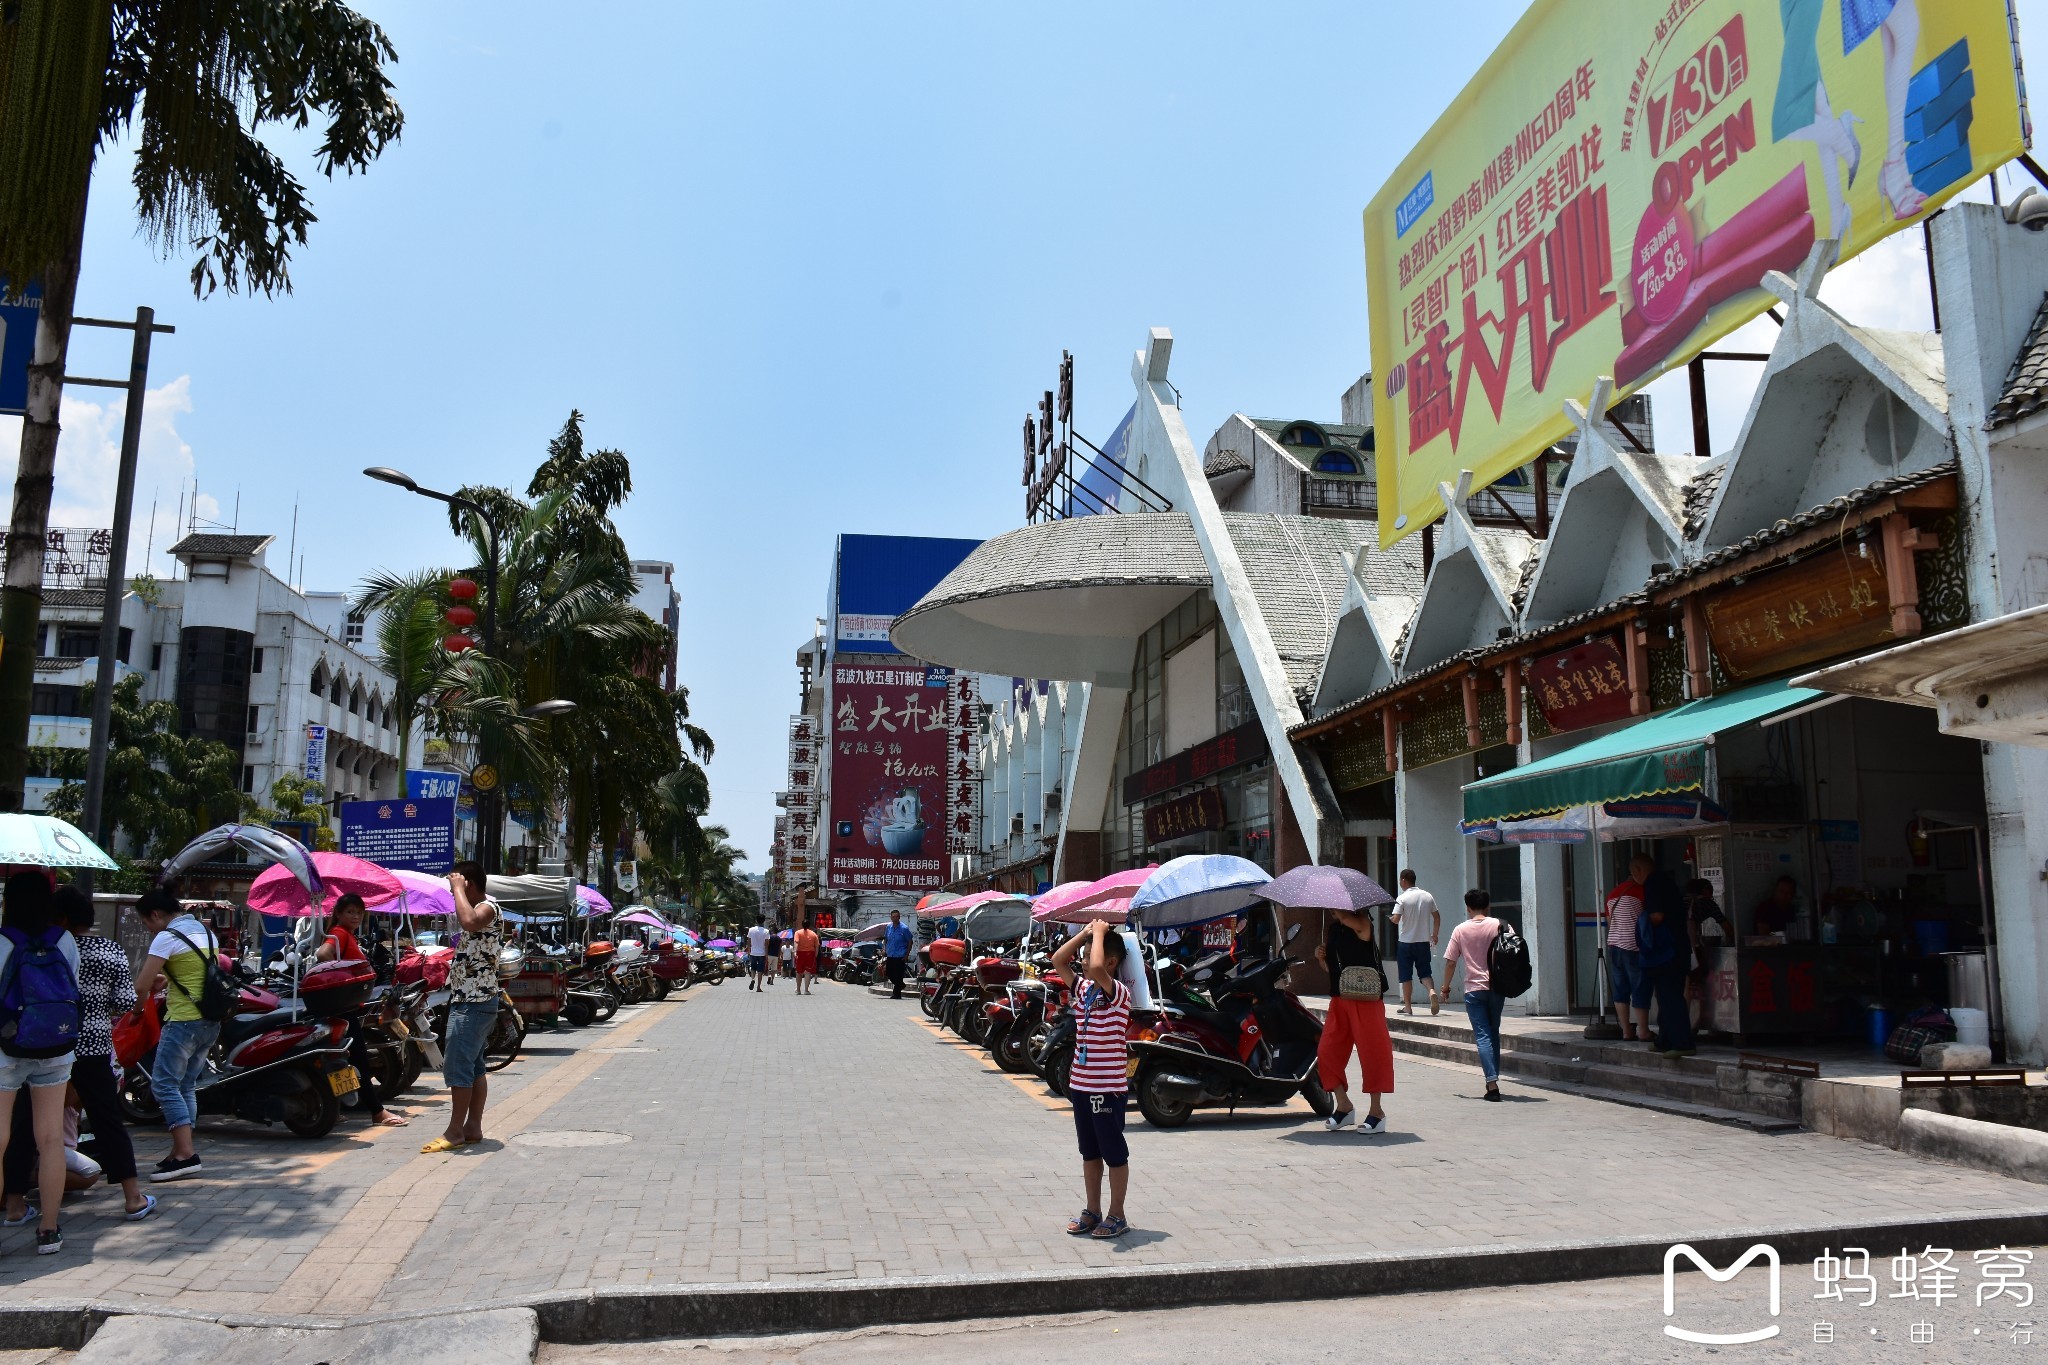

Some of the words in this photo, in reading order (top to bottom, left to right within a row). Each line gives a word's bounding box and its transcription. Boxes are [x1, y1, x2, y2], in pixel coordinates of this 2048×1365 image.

[1398, 58, 1596, 291] 热烈庆祝黔南州建州60周年
[1497, 123, 1605, 261] 红星美凯龙
[1652, 98, 1757, 218] OPEN
[1640, 216, 1678, 266] 活动时间
[1406, 182, 1618, 456] 盛大开业
[836, 668, 925, 687] 荔波九牧五星订制店
[836, 692, 949, 734] 盛大开业
[378, 803, 418, 818] 公告
[792, 723, 811, 850] 荔波糖业宾馆
